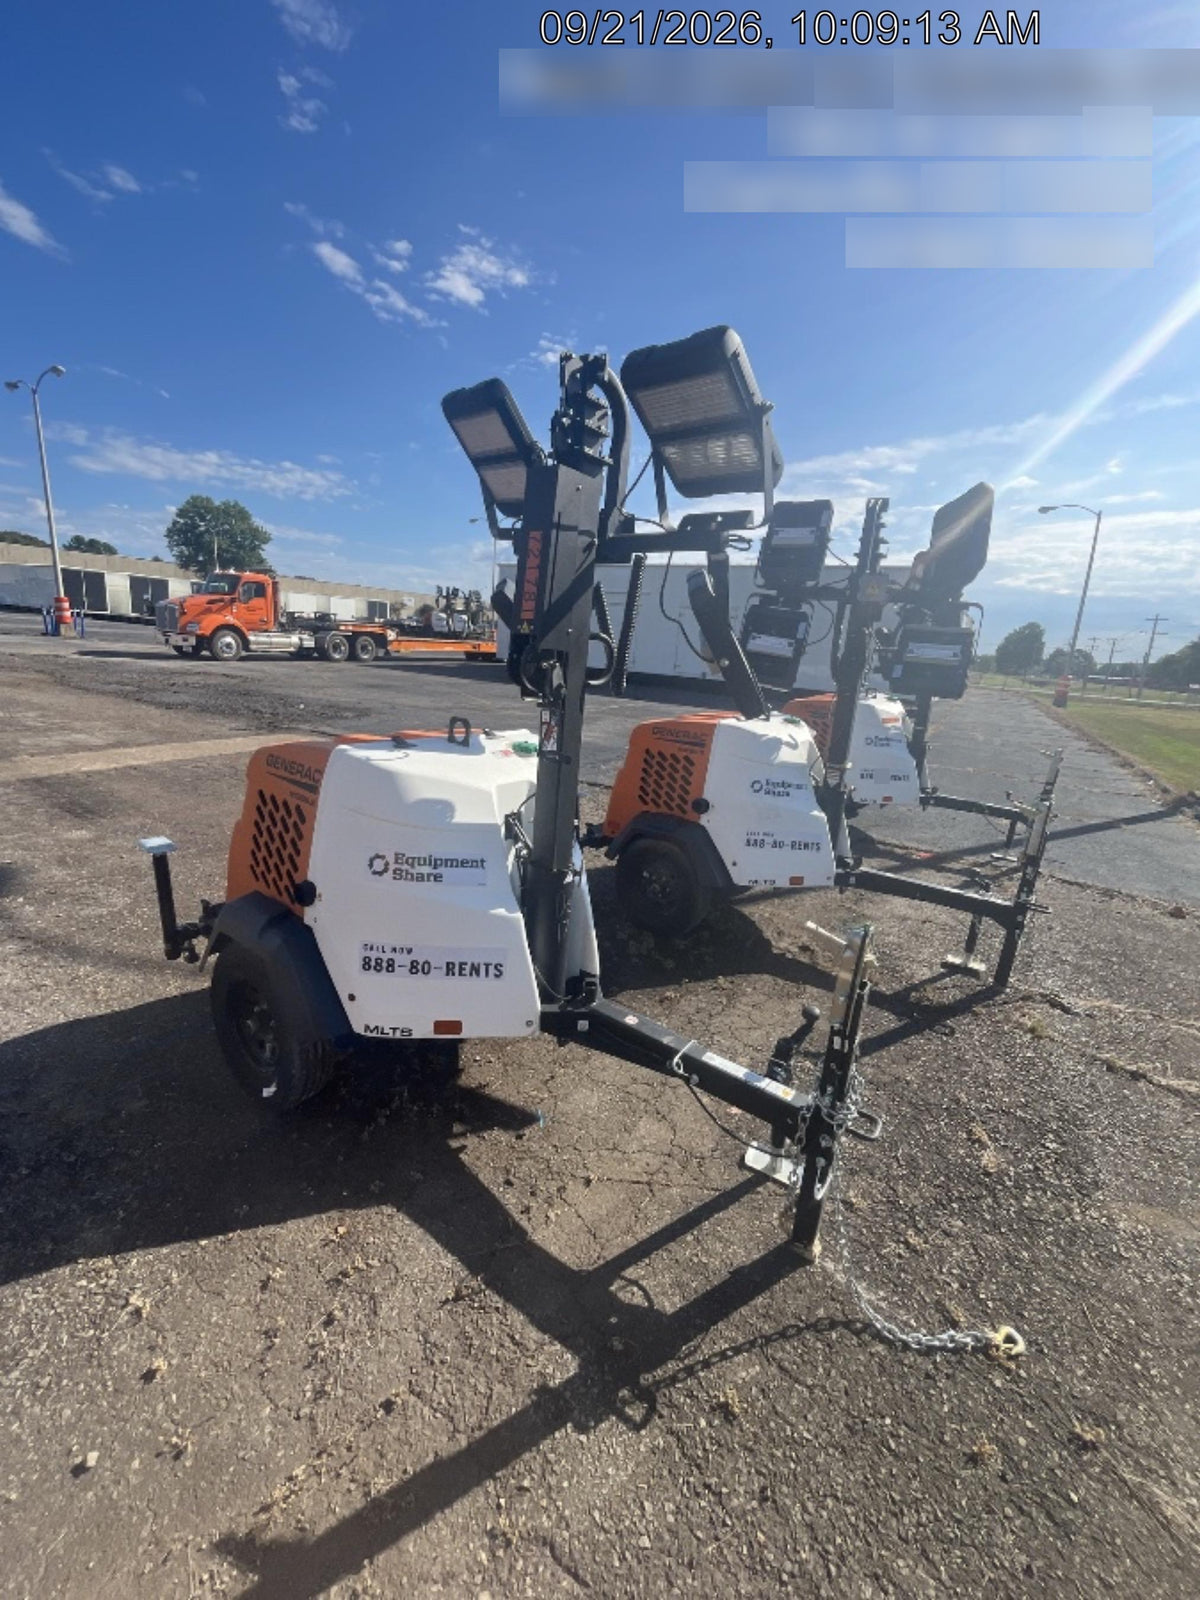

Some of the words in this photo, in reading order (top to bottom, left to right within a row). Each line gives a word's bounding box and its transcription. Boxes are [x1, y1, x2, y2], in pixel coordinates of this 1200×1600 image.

[266, 754, 323, 784] GENERAC
[393, 852, 487, 870] Equipment
[392, 868, 444, 883] Share
[362, 955, 504, 979] 888-80-RENTS
[363, 1023, 414, 1038] MLTS
